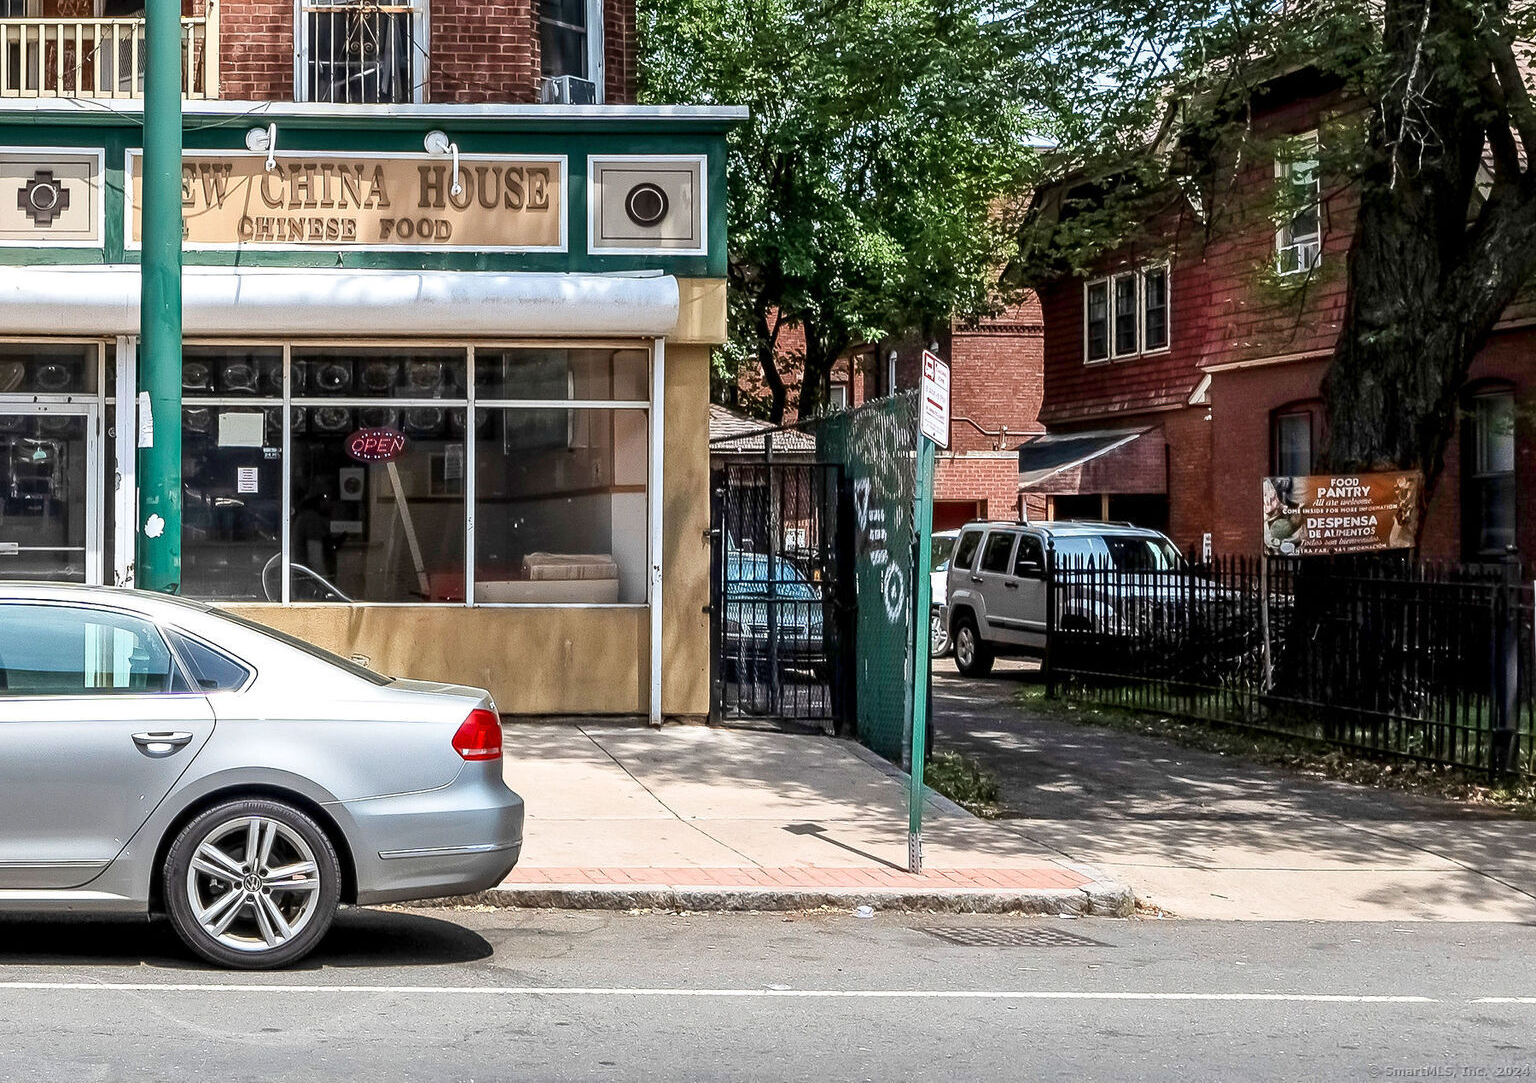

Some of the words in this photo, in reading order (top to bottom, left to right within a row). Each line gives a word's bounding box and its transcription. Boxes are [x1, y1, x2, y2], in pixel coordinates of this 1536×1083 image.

[181, 163, 233, 210] EW
[261, 163, 392, 210] CHINA
[417, 164, 551, 212] HOUSE
[238, 216, 357, 242] CHINESE
[379, 218, 453, 243] FOOD
[351, 437, 406, 453] OPEN
[1330, 477, 1360, 487] FOOD
[1317, 485, 1371, 498] PANTRY
[1312, 498, 1325, 506] All
[1282, 507, 1301, 515] COME
[1306, 515, 1378, 529] DESPENSA
[1308, 529, 1322, 538] DE
[1324, 526, 1376, 538] ALIMENTOS
